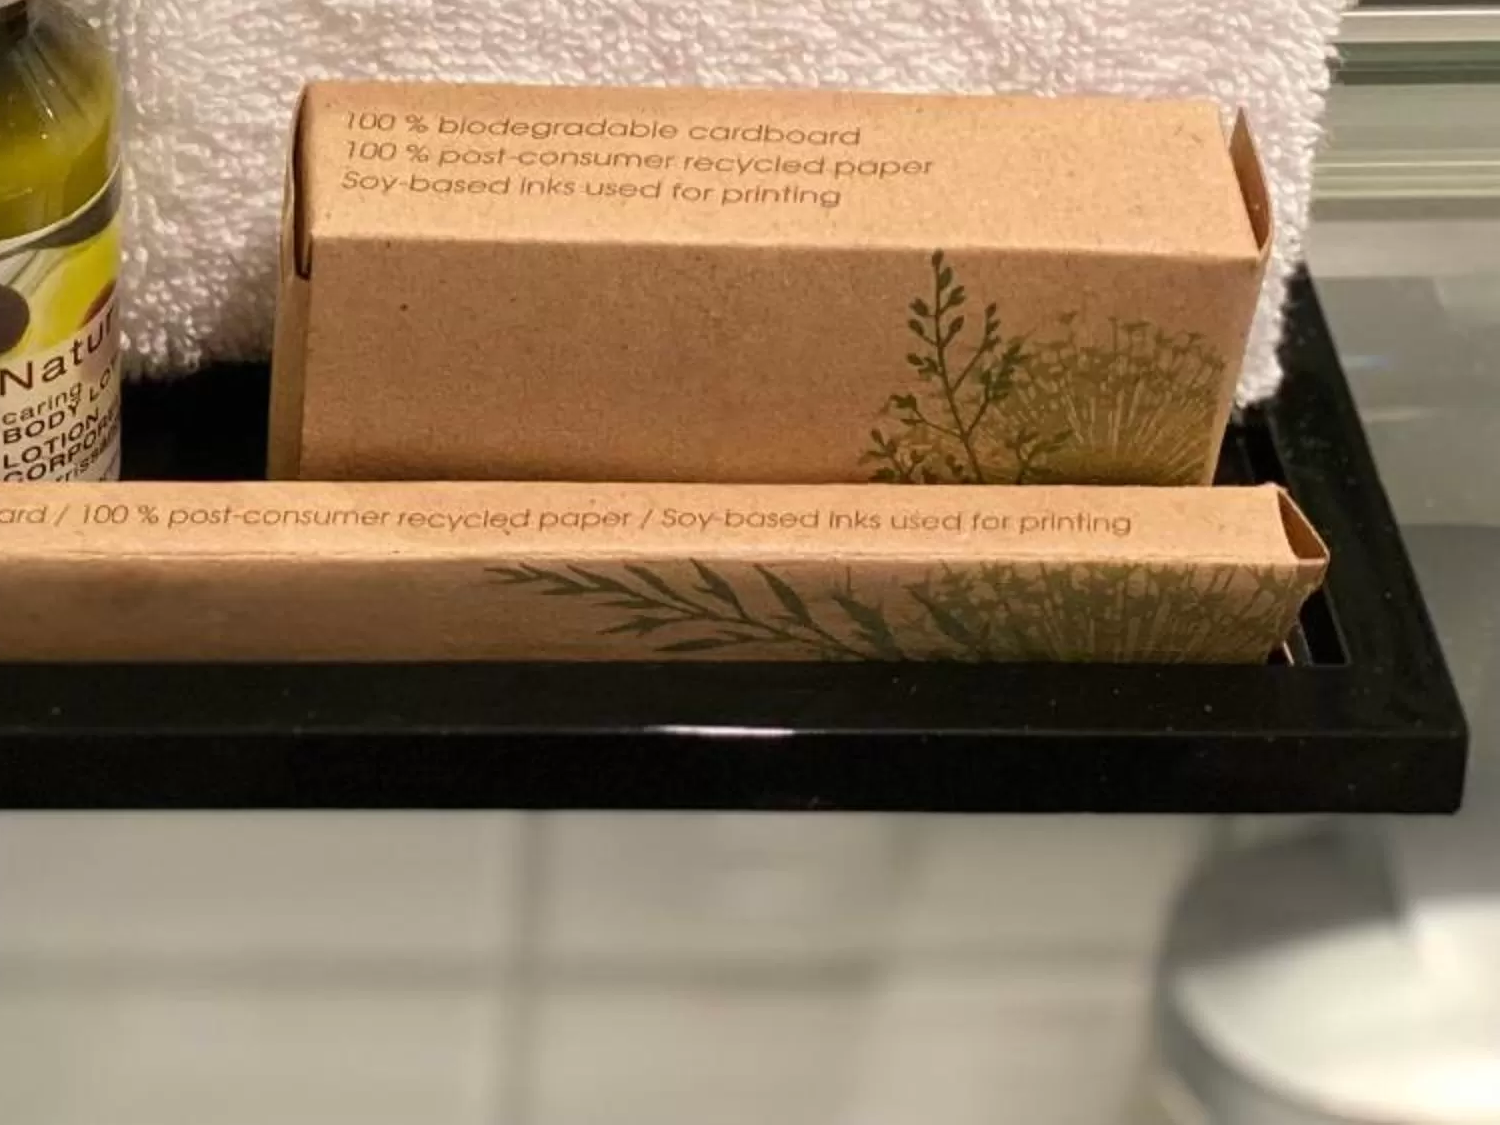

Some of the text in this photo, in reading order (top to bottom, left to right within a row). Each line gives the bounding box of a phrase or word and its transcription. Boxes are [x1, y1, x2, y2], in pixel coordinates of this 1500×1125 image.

[347, 111, 861, 147] 100 % biodegradable cardboard
[348, 140, 935, 180] 100 % post-consumer recycled paper
[341, 170, 841, 208] Soy-based inks used for printing
[2, 382, 82, 426] caring
[3, 398, 80, 444] BODY
[3, 406, 99, 470] LOTION
[53, 504, 67, 528] /
[81, 504, 128, 526] 100
[137, 505, 160, 525] %
[168, 505, 391, 531] post-consumer
[398, 507, 529, 532] recycled
[539, 510, 631, 532] paper
[639, 507, 653, 530] /
[661, 507, 819, 532] Soy-based
[829, 509, 881, 530] inks
[890, 510, 962, 531] used
[971, 511, 1009, 531] for
[1019, 511, 1132, 536] printing
